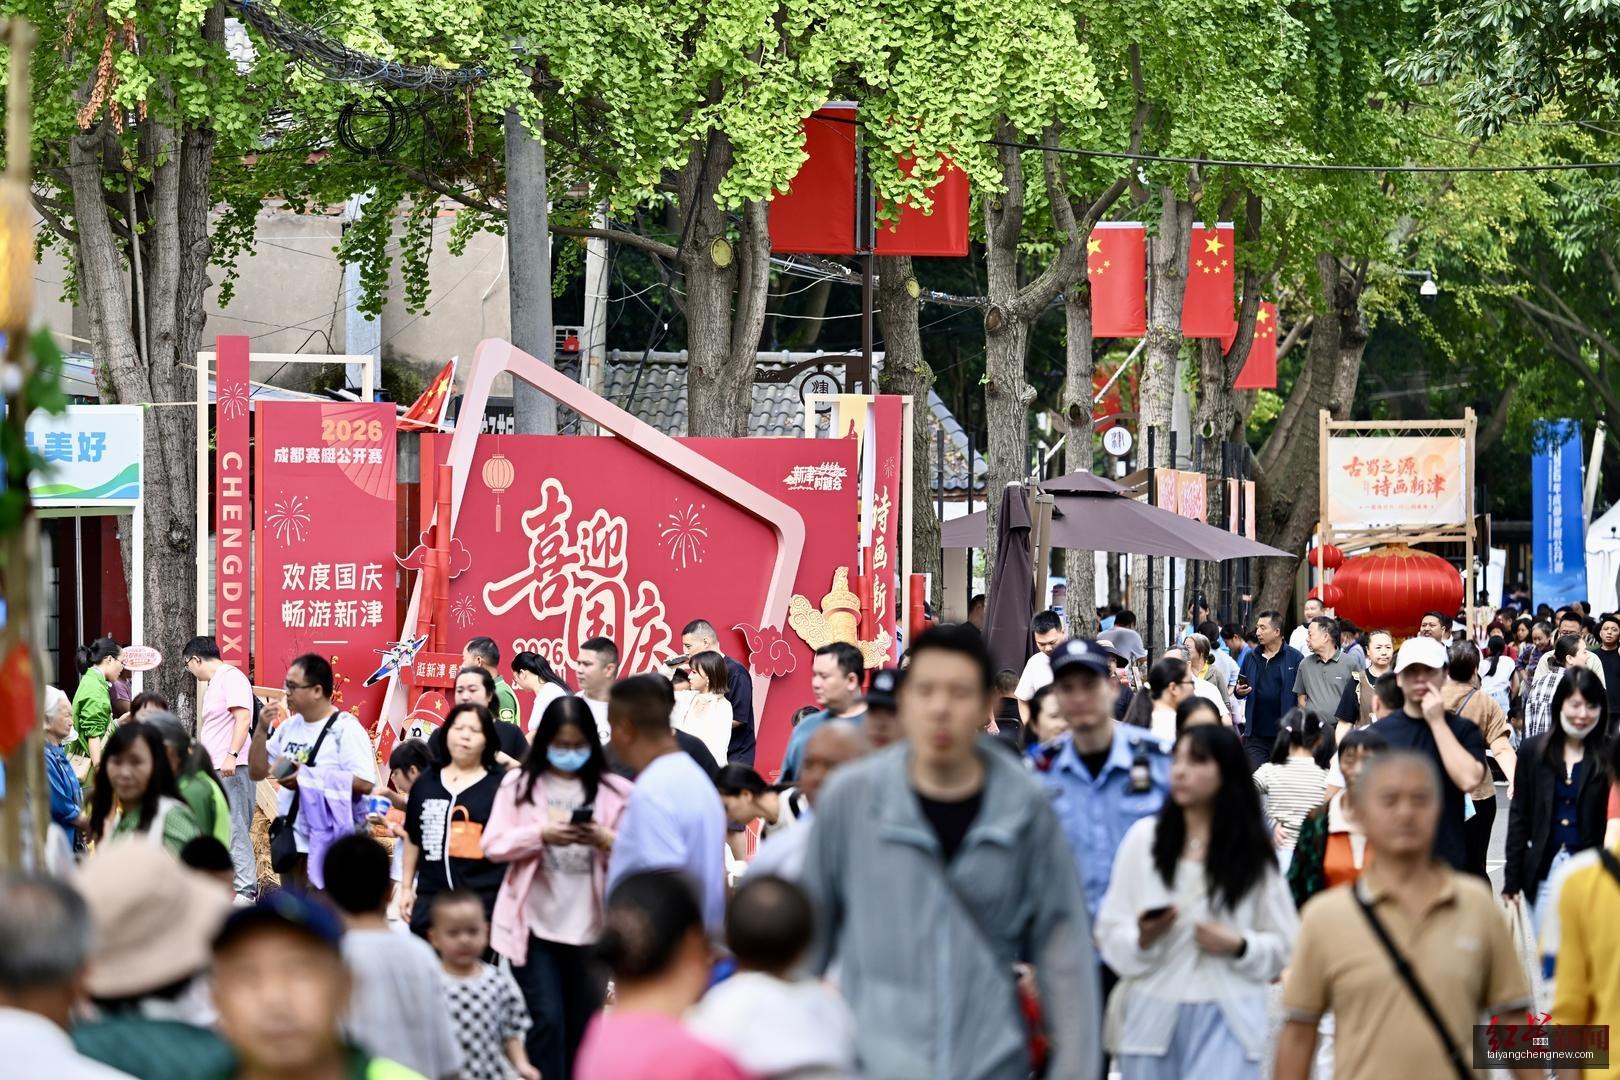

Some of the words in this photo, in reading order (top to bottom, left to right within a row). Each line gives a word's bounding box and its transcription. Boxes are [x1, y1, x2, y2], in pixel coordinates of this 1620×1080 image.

[321, 420, 383, 441] 2026
[274, 447, 383, 464] 成都赛艇公开赛
[1343, 456, 1418, 477] 古蜀之源
[1371, 474, 1446, 499] 诗画新津
[282, 563, 383, 591] 欢度国庆
[281, 600, 383, 628] 畅游新津
[416, 661, 446, 678] 逛新津
